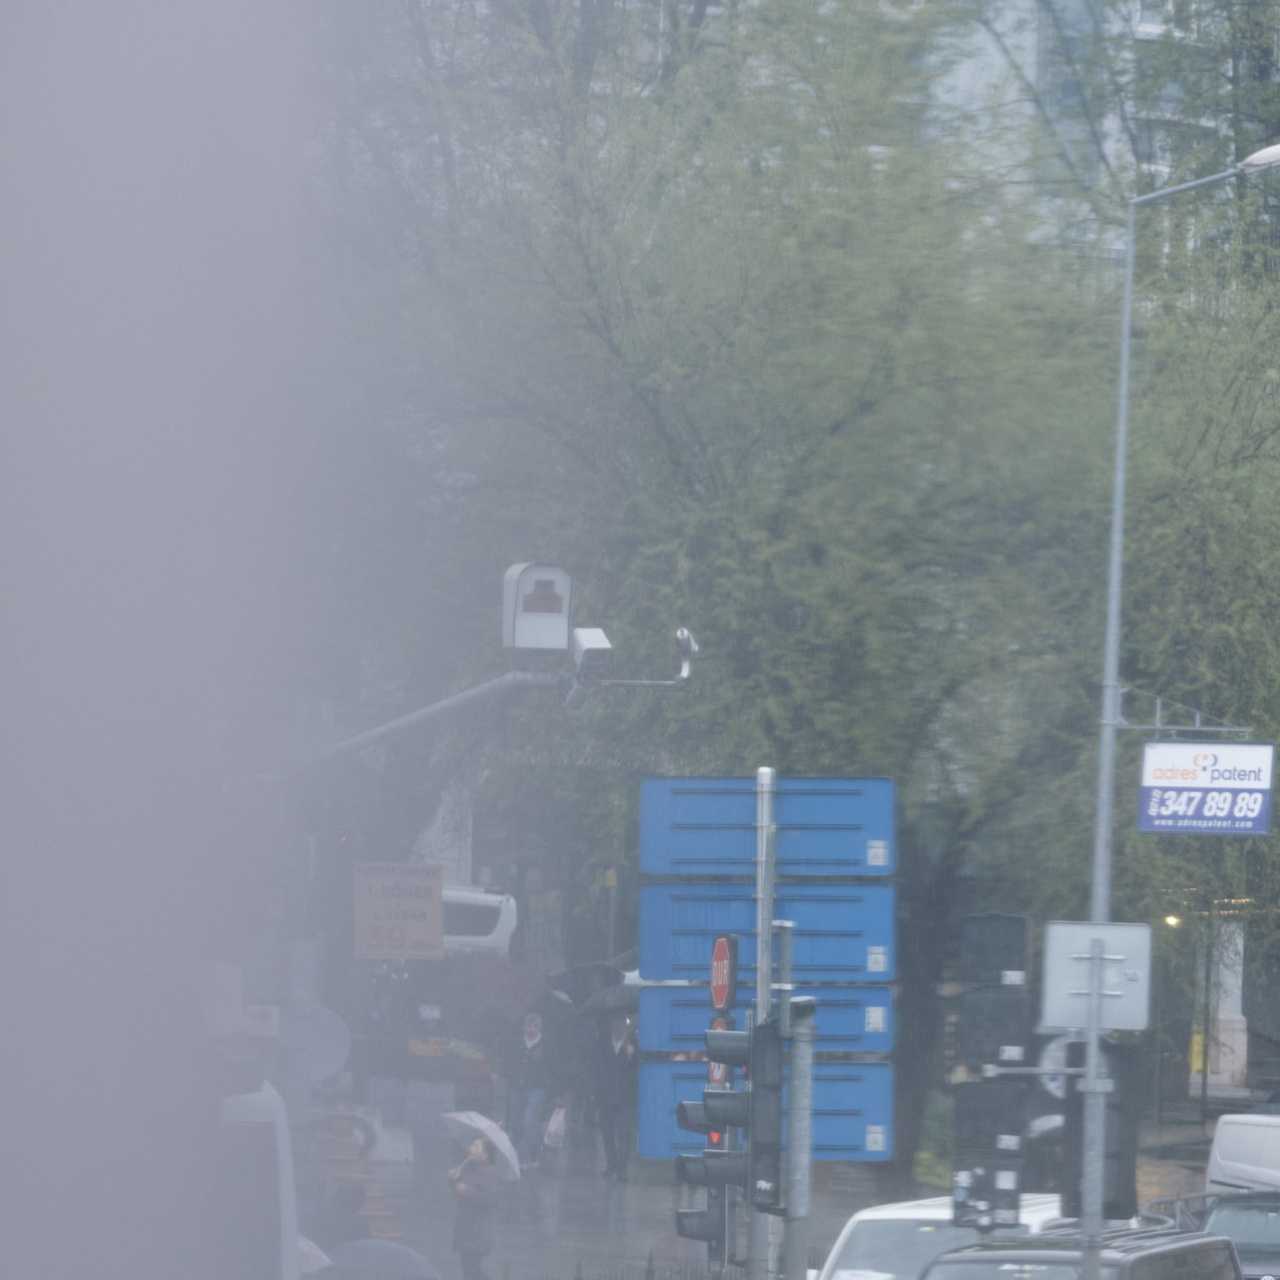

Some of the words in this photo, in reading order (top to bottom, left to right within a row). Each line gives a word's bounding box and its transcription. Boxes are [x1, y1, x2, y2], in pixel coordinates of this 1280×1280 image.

[1152, 766, 1198, 781] adres
[1210, 767, 1263, 783] patent
[1160, 791, 1202, 816] 347
[1203, 792, 1232, 817] 89
[1234, 793, 1263, 818] 89
[1153, 819, 1253, 828] www.adrespatent.com
[713, 960, 728, 986] DUR
